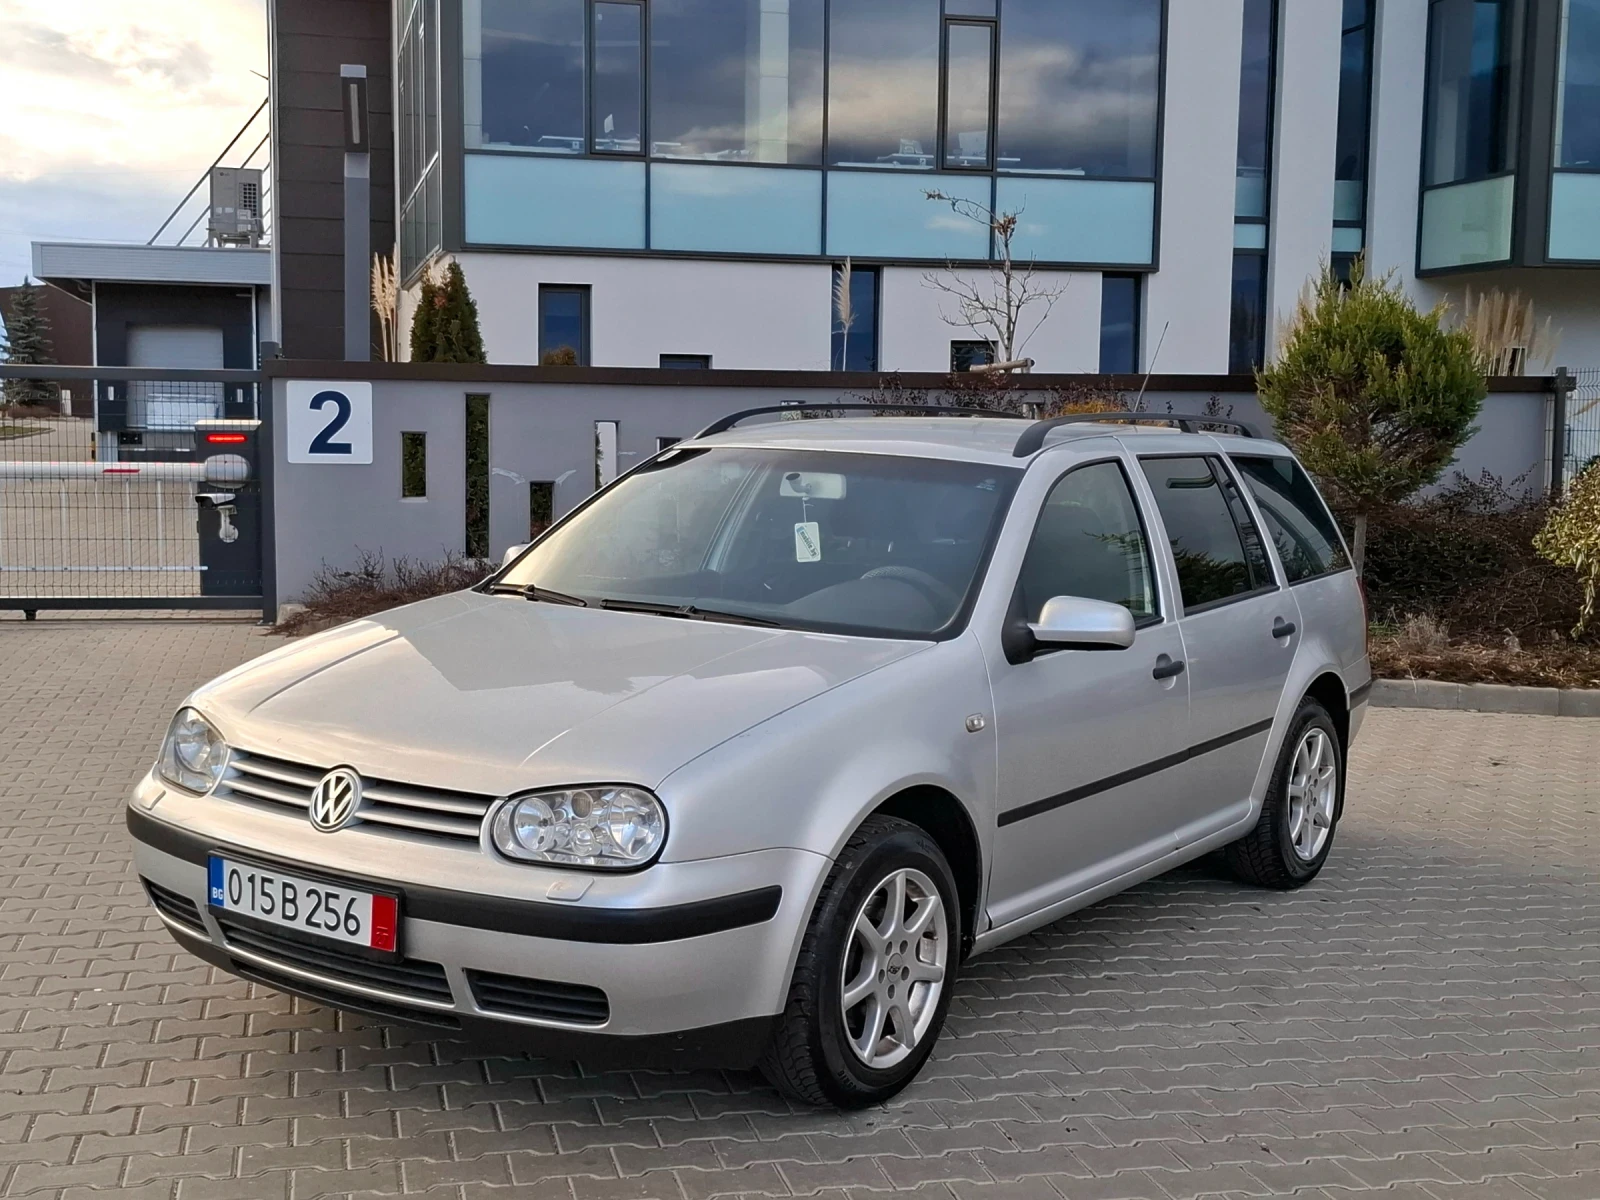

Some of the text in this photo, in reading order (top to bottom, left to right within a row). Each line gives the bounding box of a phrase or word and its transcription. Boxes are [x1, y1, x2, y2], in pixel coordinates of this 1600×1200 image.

[308, 390, 352, 454] 2
[311, 770, 357, 828] VW
[212, 886, 224, 900] BG
